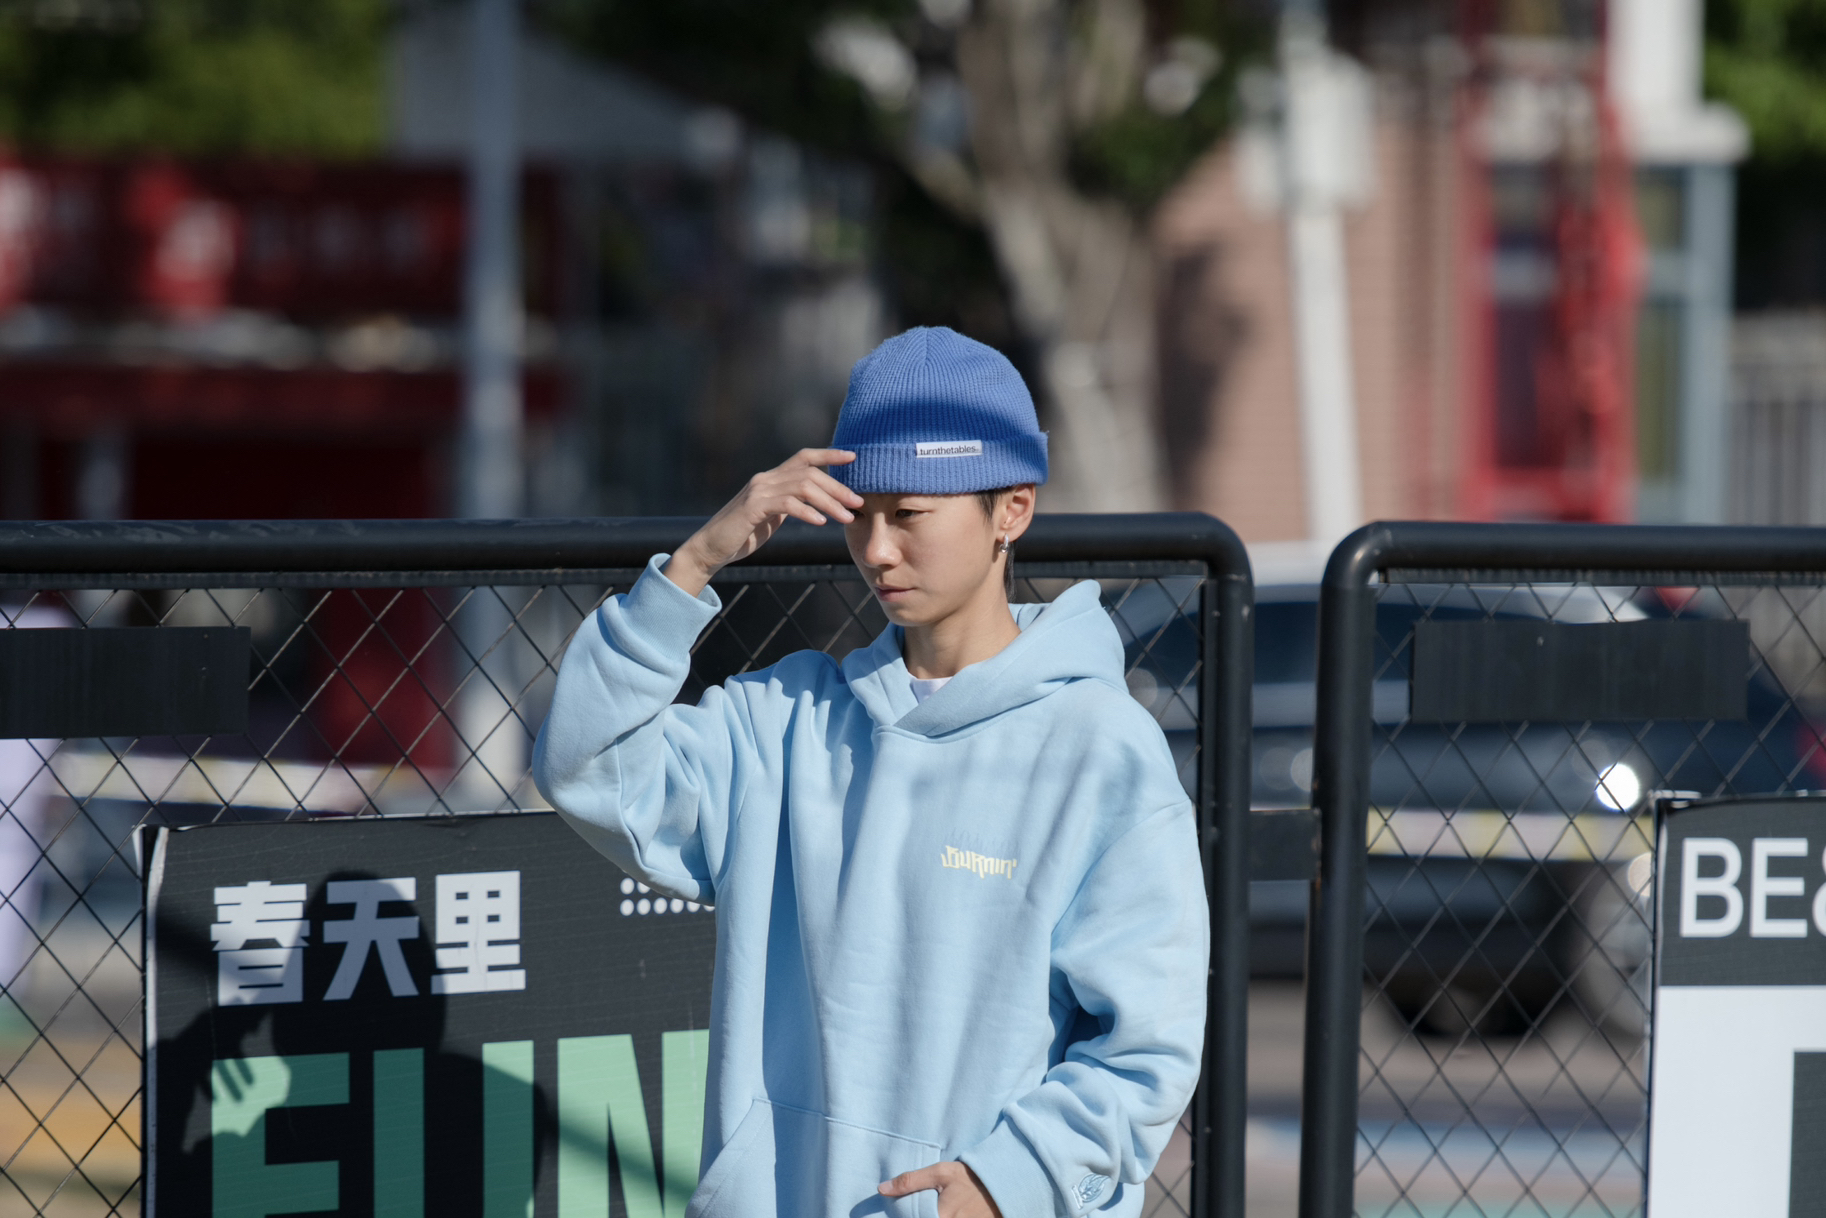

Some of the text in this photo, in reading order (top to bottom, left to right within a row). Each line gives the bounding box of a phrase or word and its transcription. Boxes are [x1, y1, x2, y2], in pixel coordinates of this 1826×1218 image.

[210, 870, 526, 1006] 春天里
[1679, 837, 1826, 938] BE
